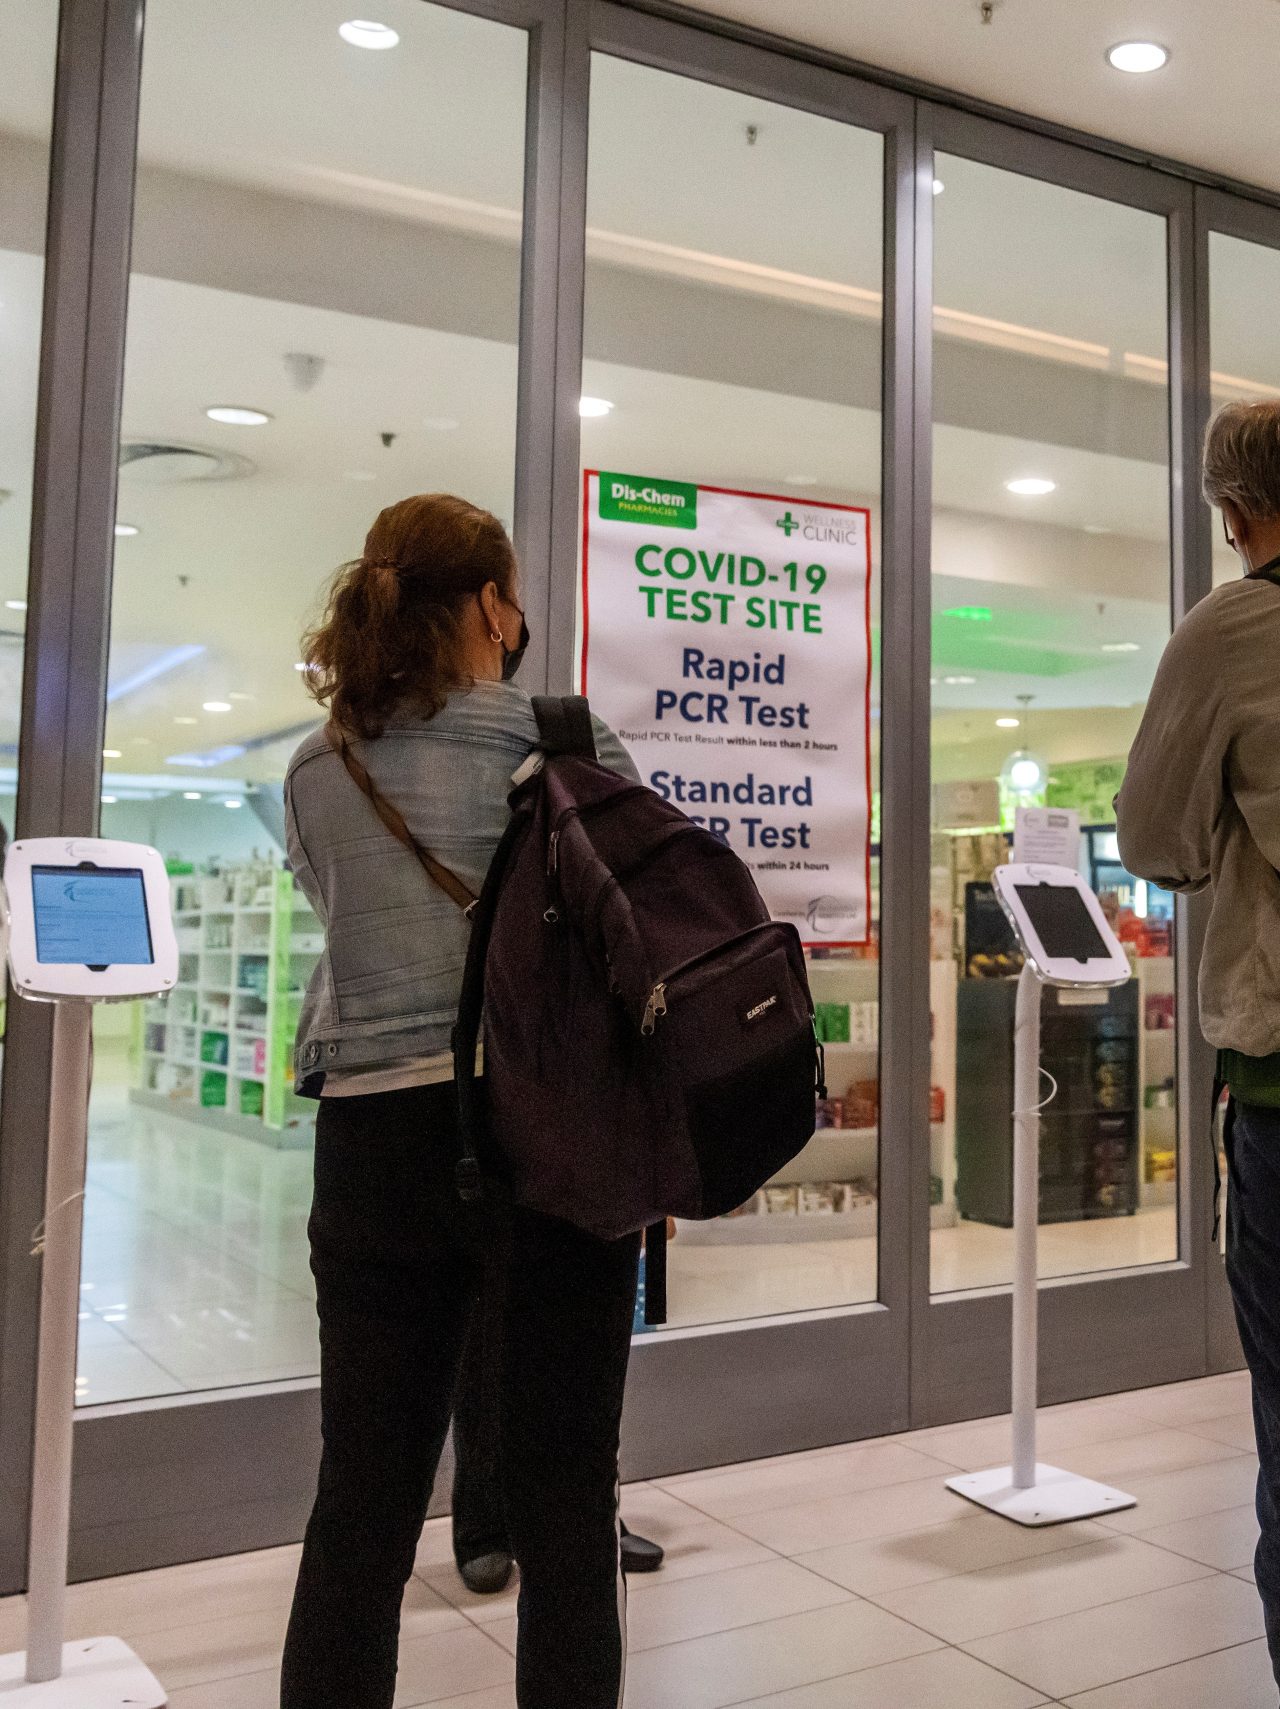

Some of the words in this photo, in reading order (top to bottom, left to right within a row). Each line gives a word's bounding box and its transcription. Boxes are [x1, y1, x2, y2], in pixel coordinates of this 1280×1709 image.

[611, 483, 685, 508] Dis-Chem
[618, 501, 677, 517] PHARMACIES
[803, 526, 857, 546] CLINIC
[635, 544, 827, 594] COVID-19
[638, 586, 735, 625] TEST
[746, 597, 823, 634] SITE
[682, 647, 785, 691] Rapid
[655, 689, 729, 724] PCR
[739, 697, 810, 729] Test
[619, 729, 648, 743] Rapid
[650, 731, 671, 742] PCR
[673, 733, 692, 743] Test
[694, 734, 724, 745] Result
[727, 736, 757, 747] within
[759, 738, 777, 748] less
[780, 739, 802, 749] than
[804, 740, 810, 750] 2
[812, 741, 838, 751] hours
[650, 770, 813, 806] Standard
[741, 817, 811, 849] Test
[757, 861, 787, 871] within
[789, 861, 802, 871] 24
[804, 861, 829, 871] hours
[746, 995, 777, 1020] EASTPAK
